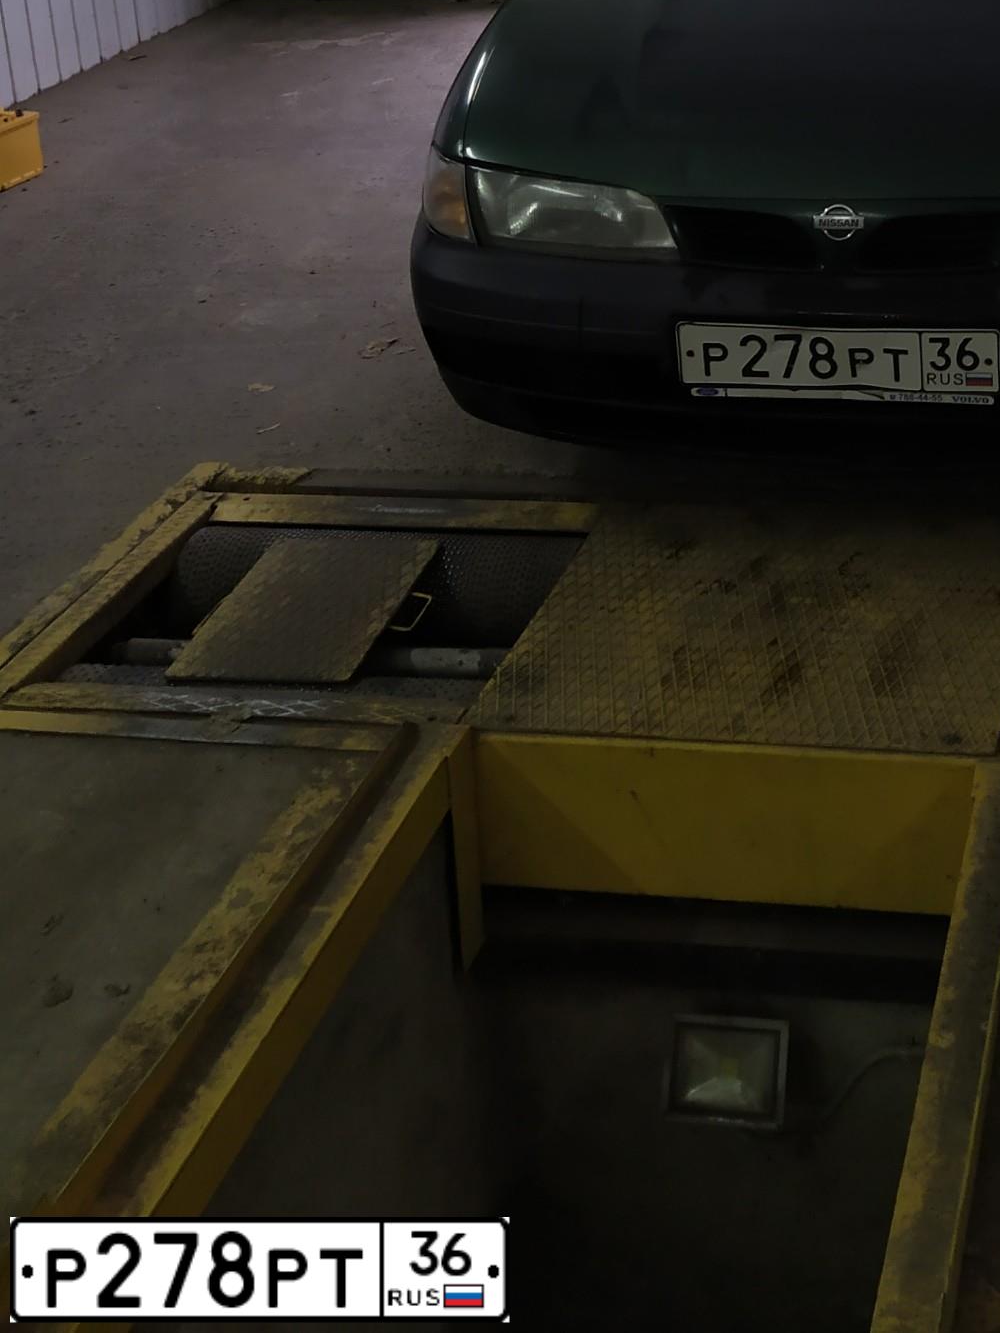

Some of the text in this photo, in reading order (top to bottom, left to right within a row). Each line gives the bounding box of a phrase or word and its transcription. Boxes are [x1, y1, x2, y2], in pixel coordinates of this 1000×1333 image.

[819, 219, 859, 227] NISSAN
[702, 334, 981, 382] Р278РТ 36
[926, 372, 965, 385] RUS
[951, 396, 990, 404] VOLVO
